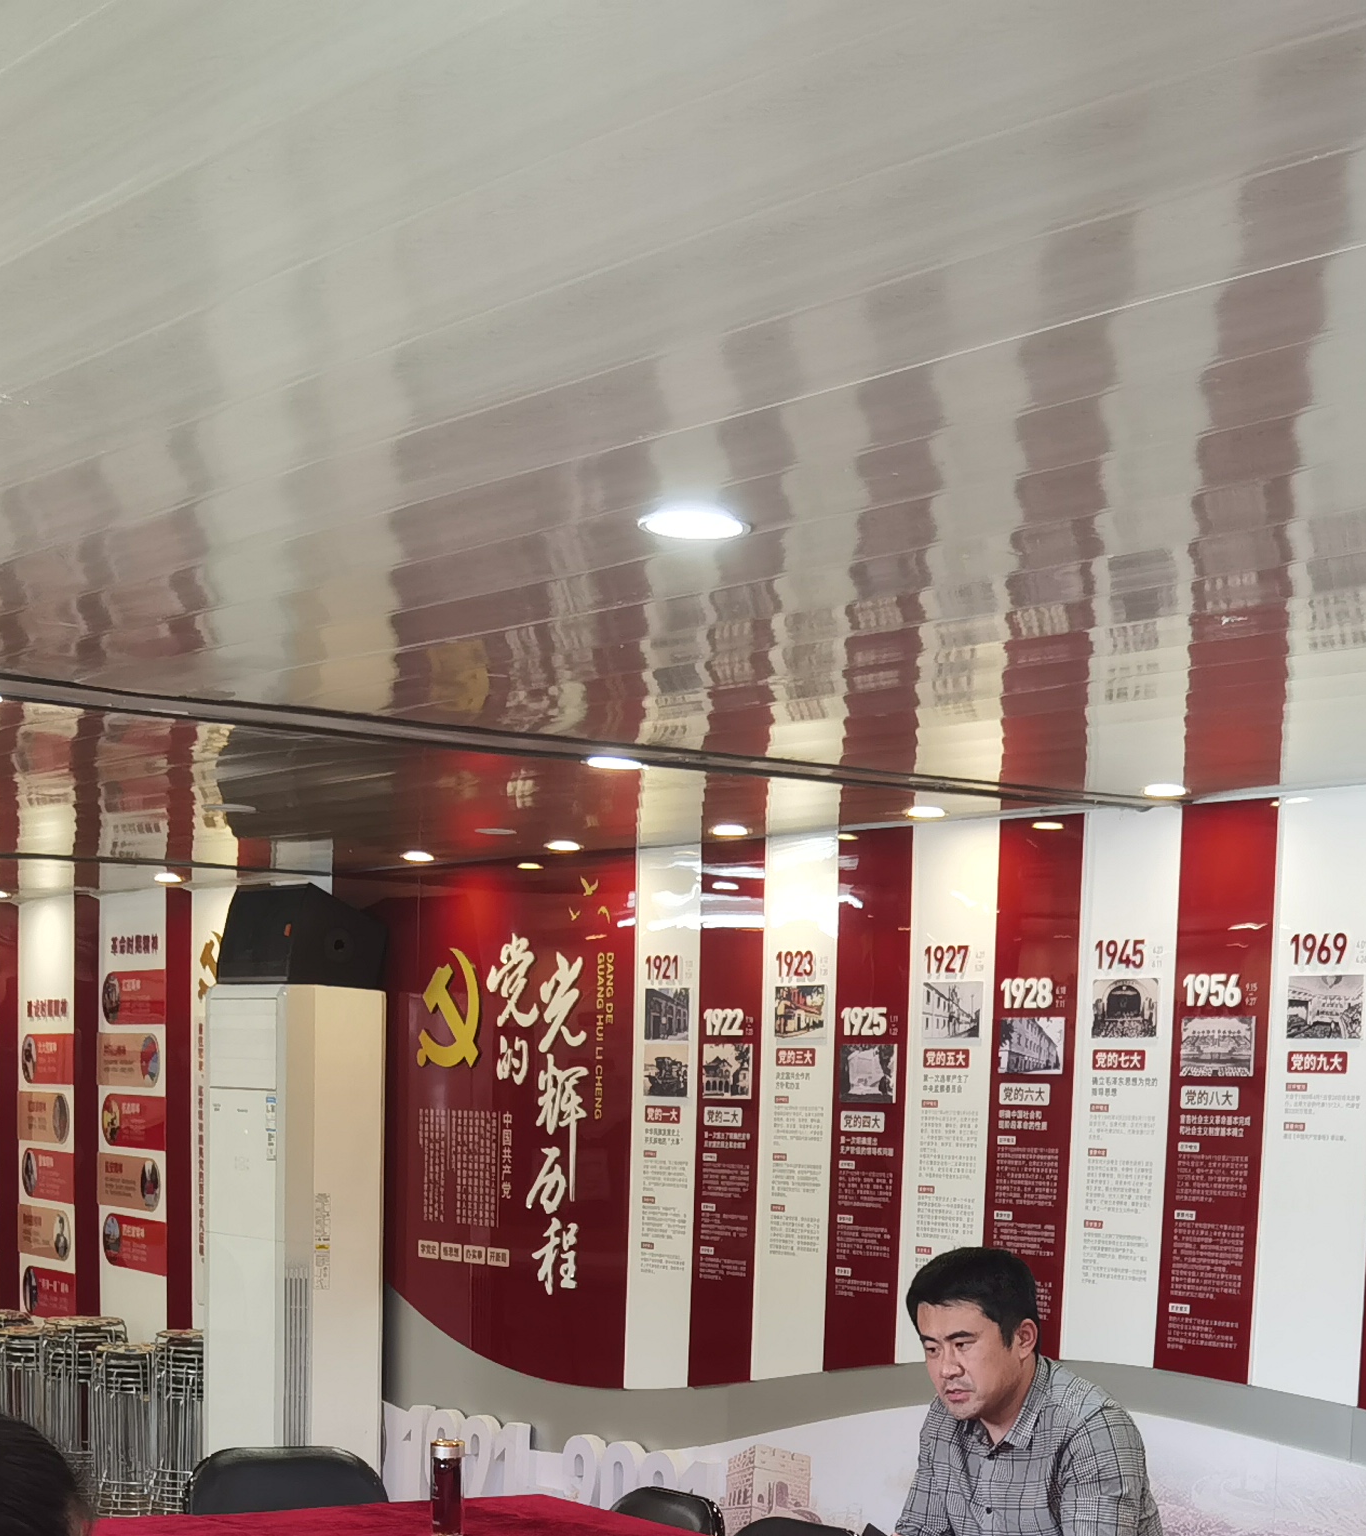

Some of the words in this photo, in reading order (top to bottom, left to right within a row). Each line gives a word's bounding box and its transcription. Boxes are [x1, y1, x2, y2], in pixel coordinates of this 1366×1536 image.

[924, 945, 969, 974] 1927
[1095, 939, 1145, 970] 1945
[1290, 932, 1348, 965] 1969
[605, 952, 614, 997] DANG
[645, 954, 679, 980] 1921
[776, 950, 814, 977] 1923
[596, 952, 604, 1009] GUANG
[1000, 977, 1053, 1009] 1928
[1183, 973, 1243, 1008] 1956
[486, 933, 539, 1085] 党的
[605, 1003, 613, 1024] DE
[703, 1008, 744, 1036] 1922
[841, 1007, 887, 1036] 1925
[595, 1015, 603, 1041] HUI
[595, 1047, 603, 1060] LI
[778, 1051, 812, 1064] 党的三大
[926, 1051, 966, 1066] 党的五大
[1095, 1052, 1142, 1068] 党的七大
[1290, 1054, 1343, 1071] 党的九大
[594, 1065, 603, 1120] CHENG
[1003, 1086, 1045, 1102] 党的六大
[1091, 1088, 1118, 1097] 指导思想
[1185, 1090, 1233, 1106] 党的八大
[525, 951, 589, 1296] 光辉历程
[647, 1108, 678, 1121] 党的一大
[707, 1110, 739, 1123] 党的二大
[844, 1115, 880, 1128] 党的四大
[501, 1111, 512, 1200] 中国共产党
